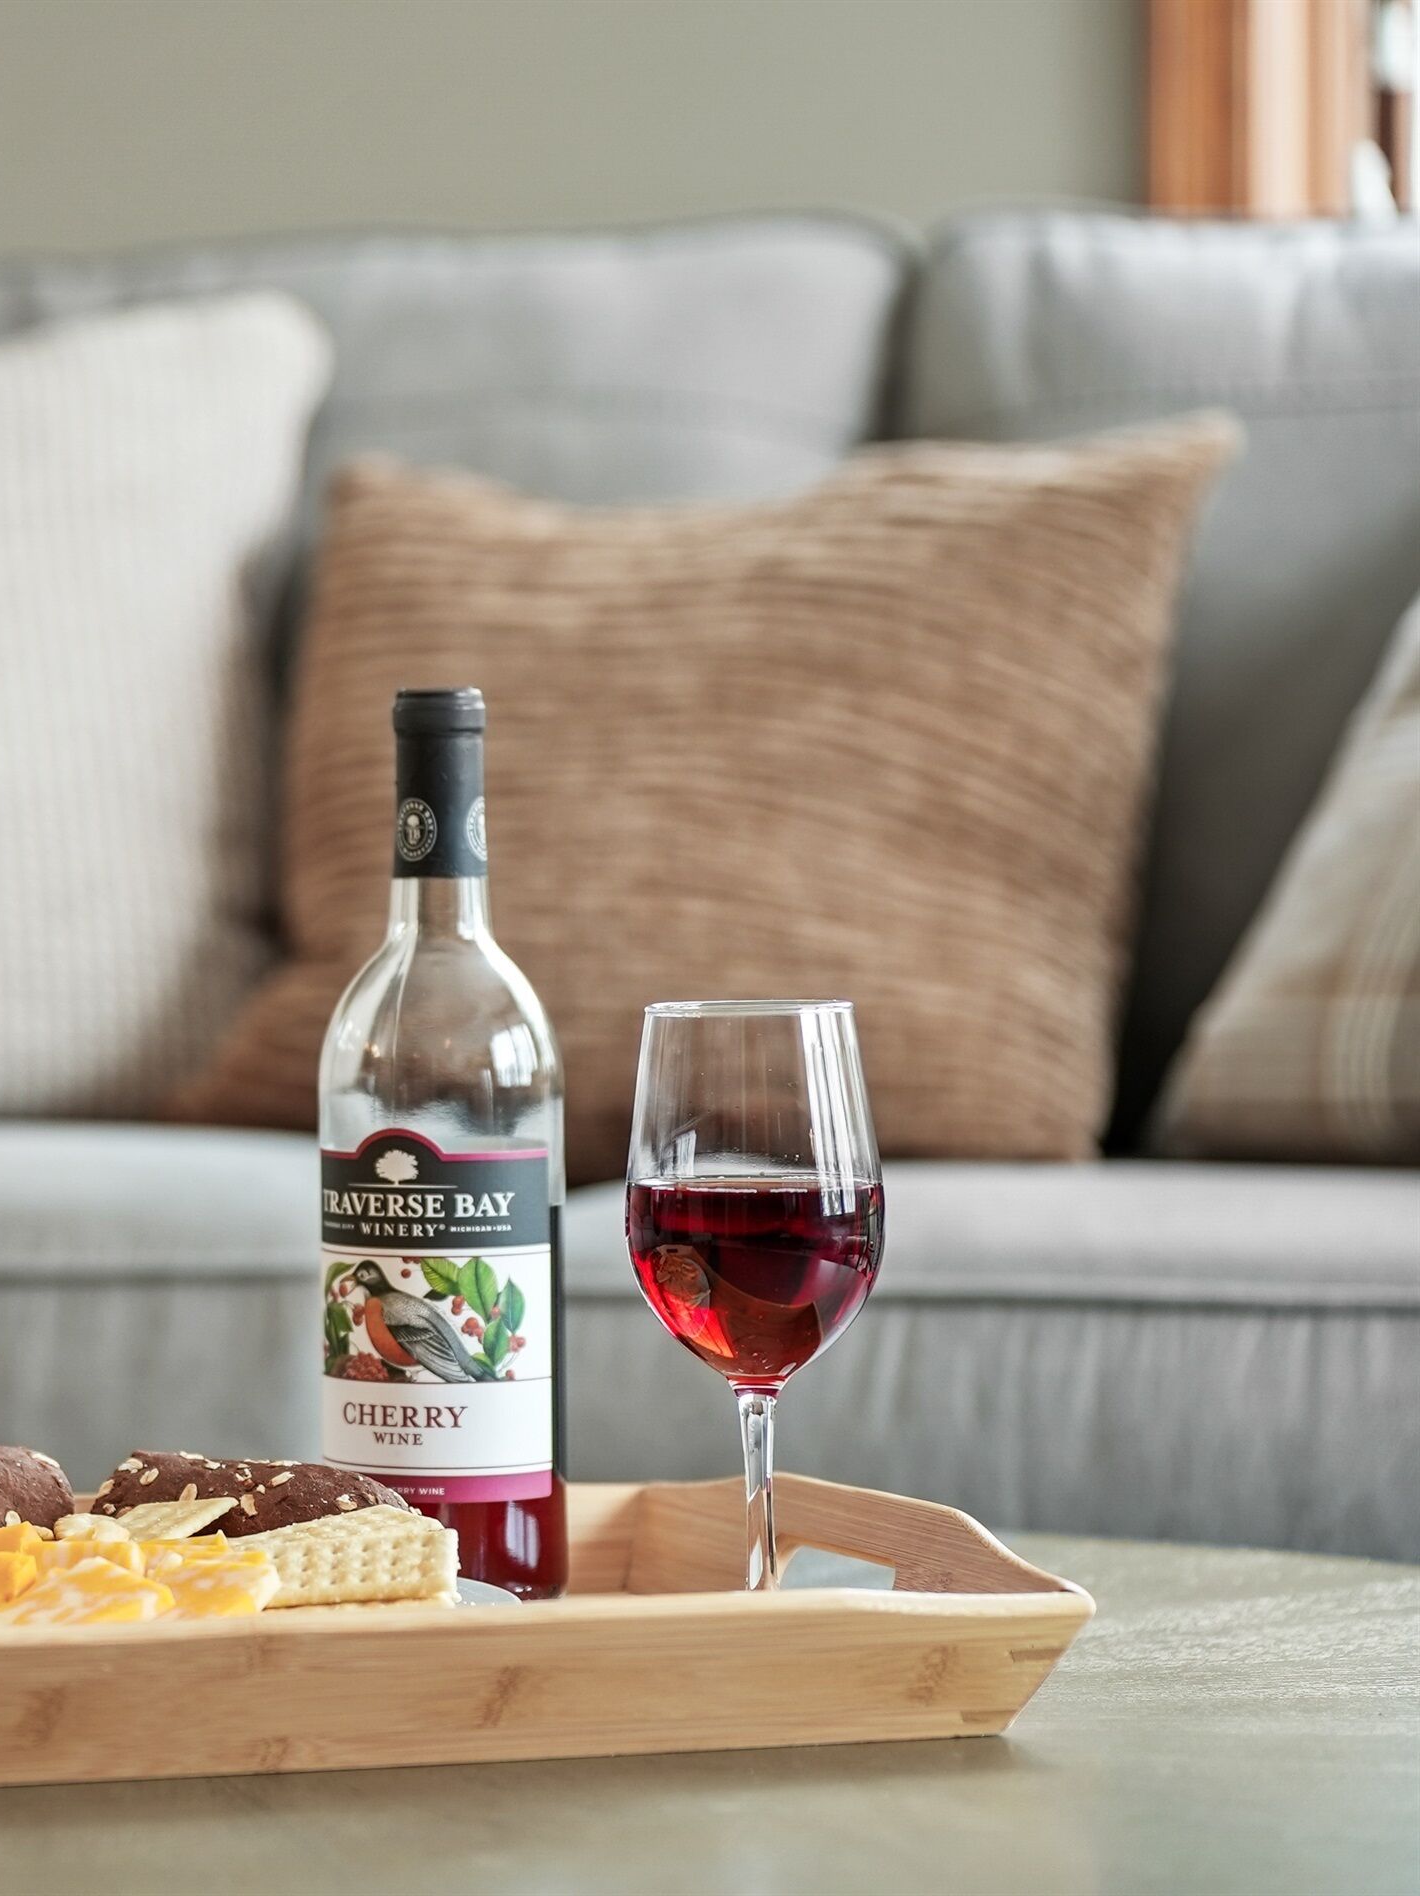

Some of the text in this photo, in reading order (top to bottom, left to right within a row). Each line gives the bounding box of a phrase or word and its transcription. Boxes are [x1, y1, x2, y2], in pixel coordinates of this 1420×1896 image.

[323, 1189, 516, 1218] TRAVERSE BAY
[343, 1401, 468, 1428] CHERRY
[373, 1431, 423, 1446] WINE
[419, 1487, 446, 1496] WINE
